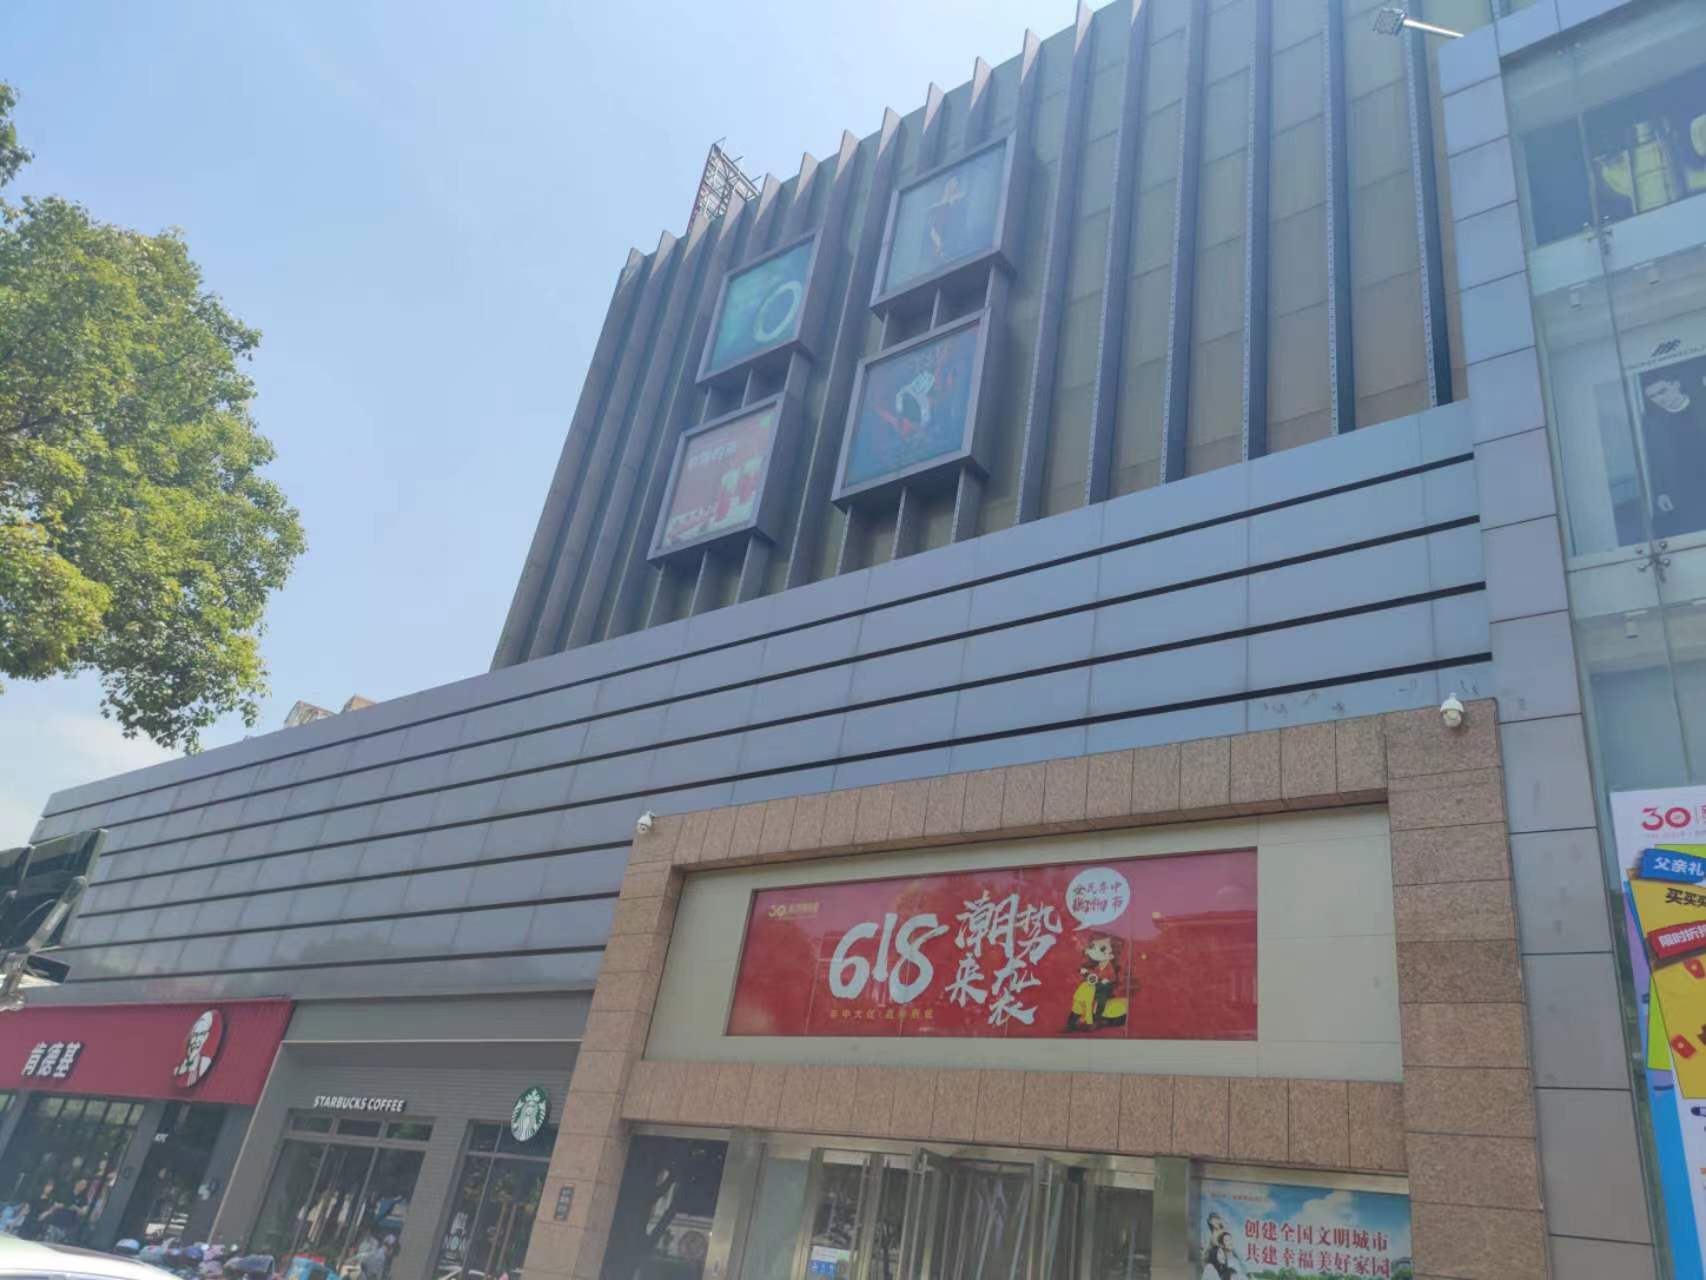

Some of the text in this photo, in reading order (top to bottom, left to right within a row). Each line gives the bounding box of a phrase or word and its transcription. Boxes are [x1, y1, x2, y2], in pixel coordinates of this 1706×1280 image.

[1653, 856, 1705, 876] 父亲礼
[829, 912, 949, 1004] 618
[21, 1041, 81, 1078] 肯德基
[313, 1095, 405, 1112] STARBUCKS COFFEE
[1244, 1219, 1388, 1253] 创建全国文明城市
[1246, 1242, 1391, 1277] 共建幸福美好家园
